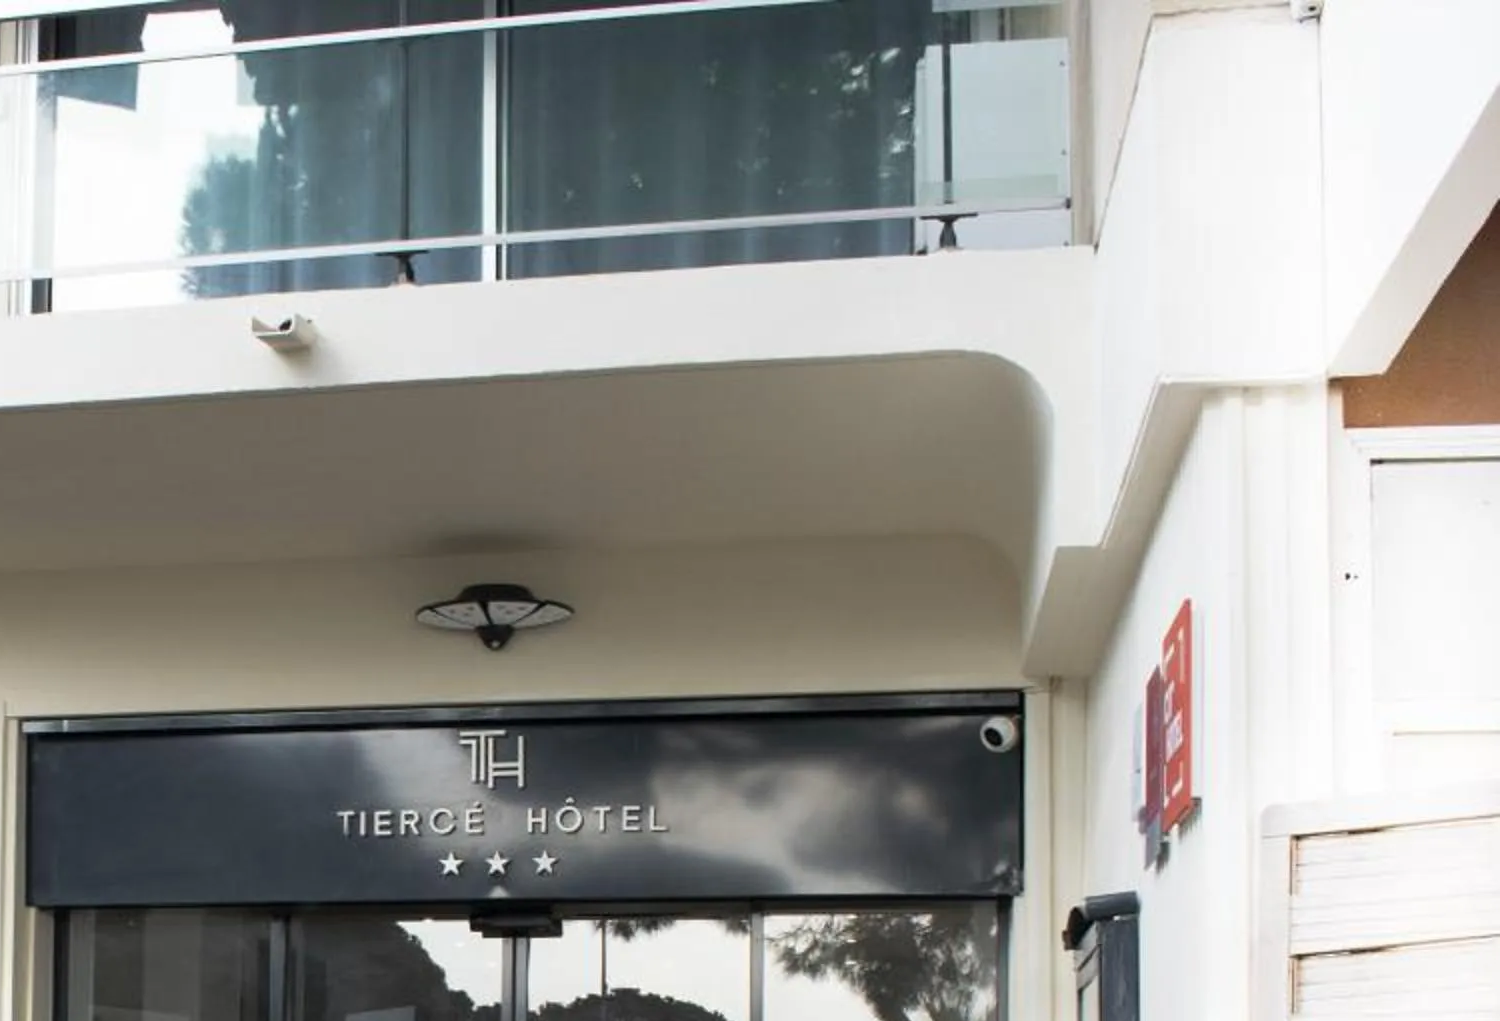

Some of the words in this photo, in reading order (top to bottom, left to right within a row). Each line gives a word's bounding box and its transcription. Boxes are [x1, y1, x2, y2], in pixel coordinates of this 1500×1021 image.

[460, 730, 525, 788] TH
[337, 802, 485, 836] TIERCÉ
[527, 797, 669, 833] HÔTEL
